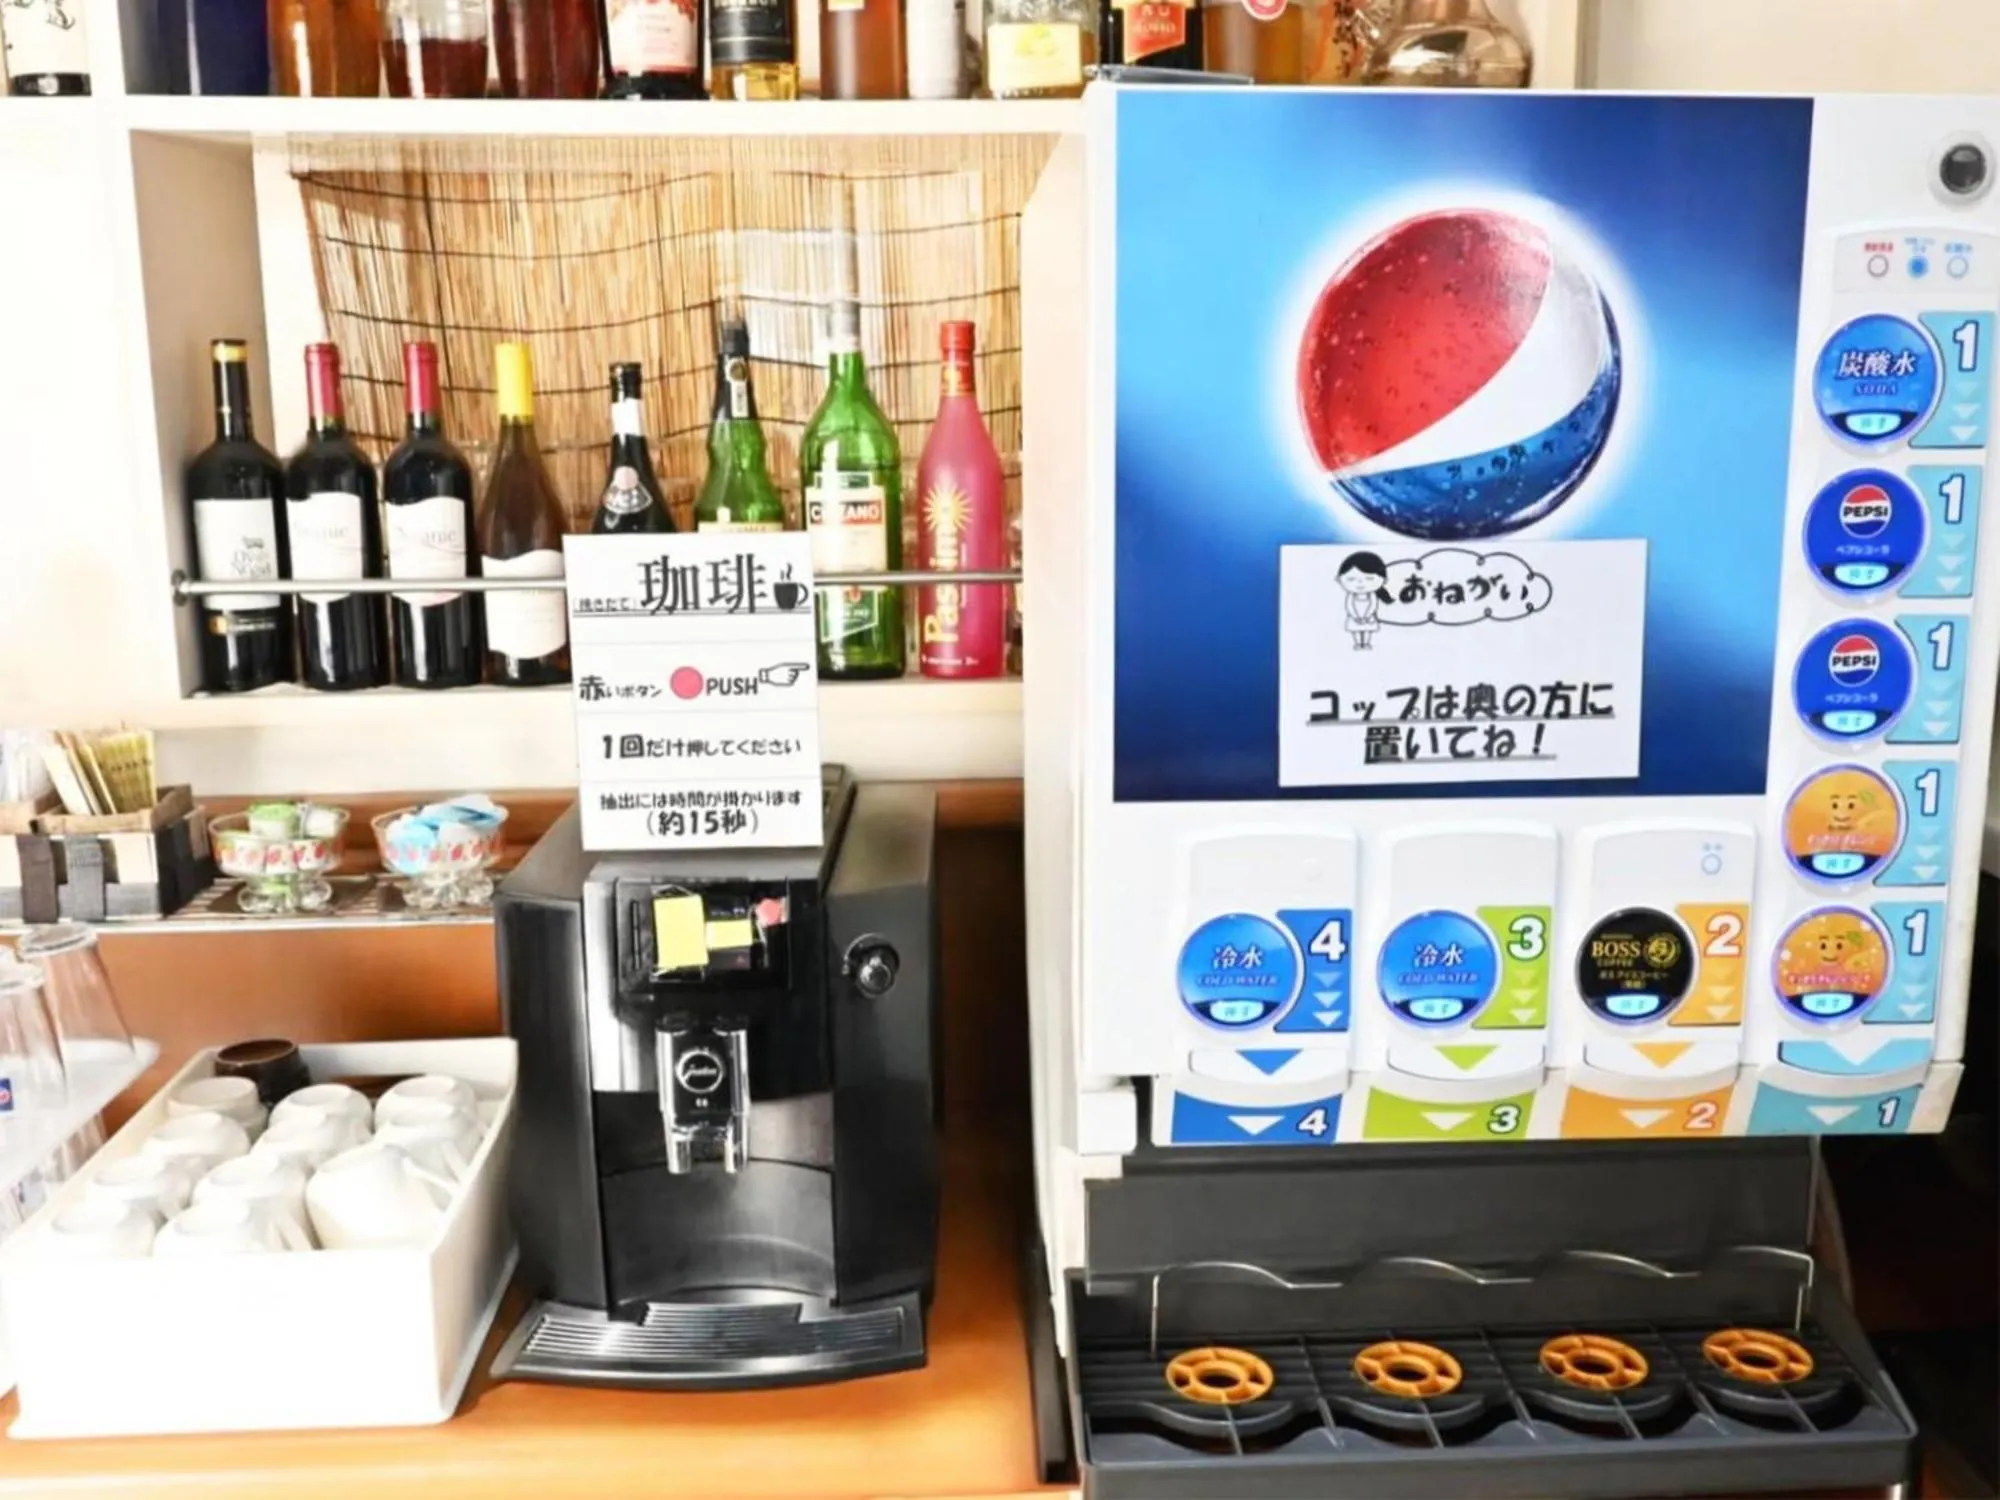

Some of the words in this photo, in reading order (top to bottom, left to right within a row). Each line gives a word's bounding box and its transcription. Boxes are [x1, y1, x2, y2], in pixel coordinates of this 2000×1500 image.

[1953, 320, 1979, 371] 1
[1838, 350, 1917, 377] 炭酸水
[1855, 382, 1897, 395] SODA
[809, 503, 881, 522] CZANO
[1843, 505, 1889, 518] PEPSI
[1939, 473, 1965, 524] 1
[637, 553, 767, 616] 珈琲
[1399, 573, 1529, 605] おねがい
[1832, 654, 1877, 668] PEPSI
[1927, 622, 1954, 670] 1
[578, 674, 662, 701] 赤いボタン
[705, 676, 759, 696] PUSH
[1309, 681, 1615, 722] コップは奥の方に
[601, 733, 803, 759] 1回だけ押してください
[1364, 722, 1547, 765] 置いてね！
[600, 789, 803, 811] 抽出には時間が掛かります
[1915, 768, 1941, 817] 1
[1308, 917, 1349, 963] 4
[1506, 913, 1547, 962] 3
[1703, 910, 1745, 959] 2
[1903, 909, 1930, 957] 1
[1213, 944, 1263, 970] 冷水
[1414, 943, 1465, 968] 冷水
[1591, 940, 1641, 958] BOSS
[1235, 974, 1279, 987] WATER
[1436, 972, 1479, 985] WATER
[1296, 1107, 1329, 1137] 4
[1487, 1103, 1522, 1134] 3
[1683, 1101, 1719, 1131] 2
[1878, 1097, 1901, 1128] 1
